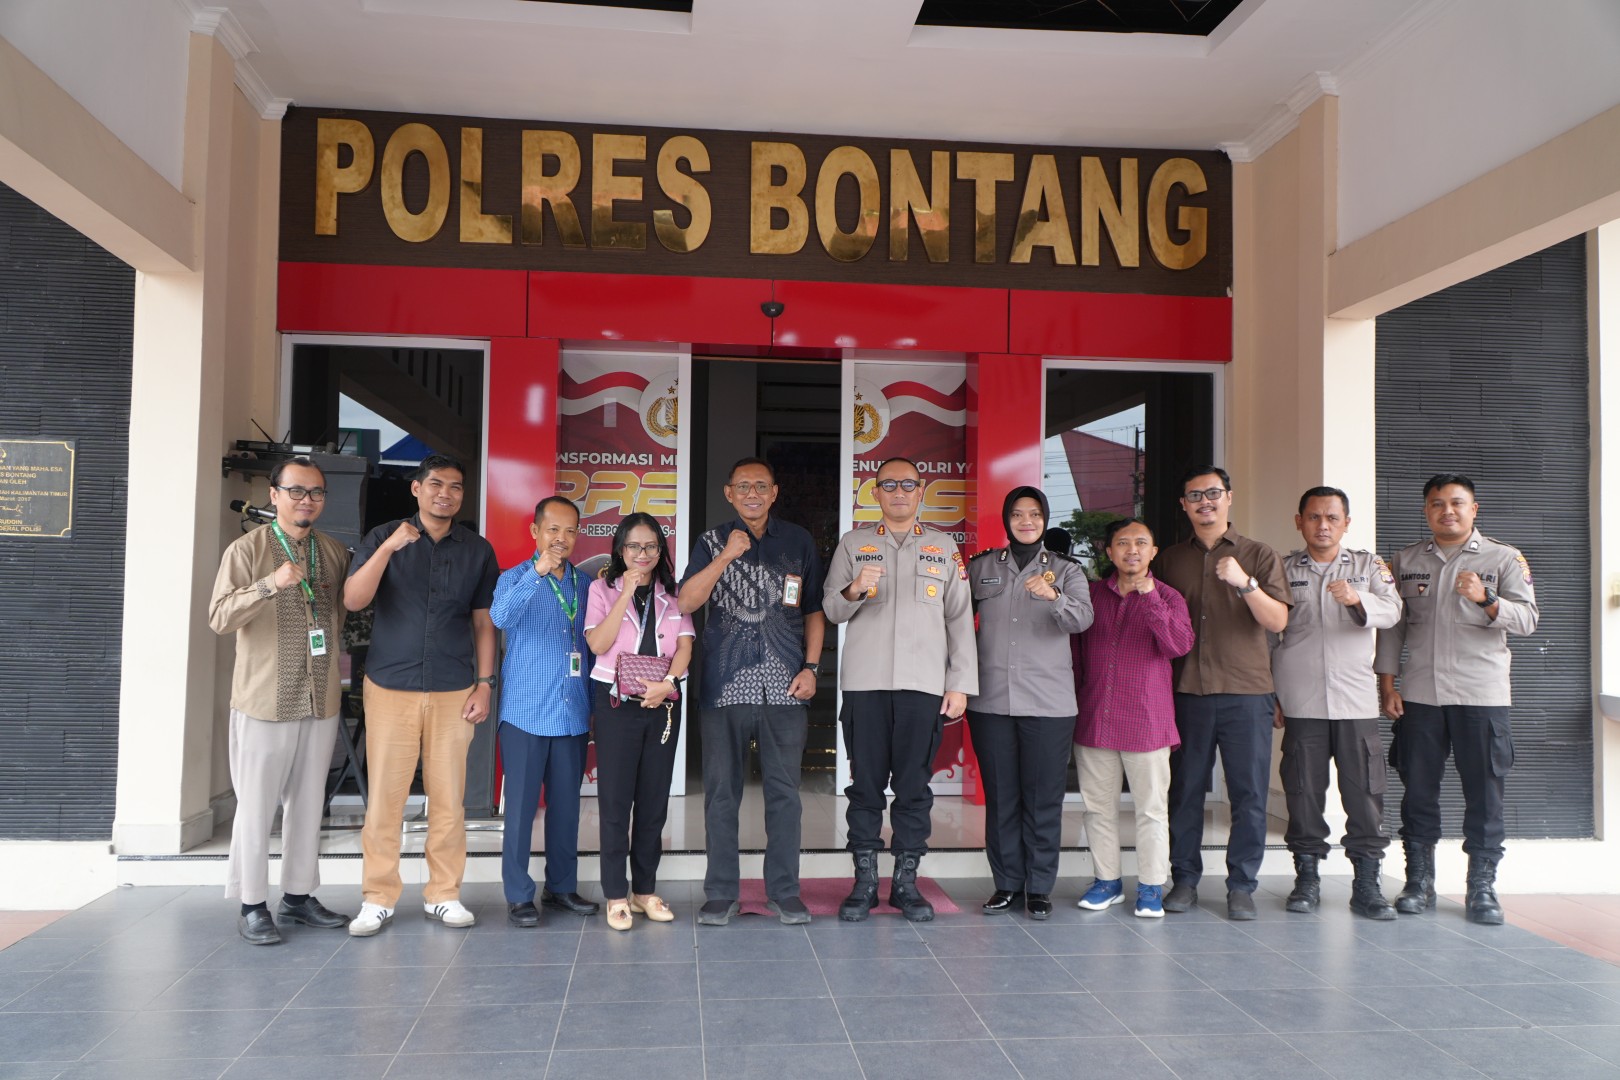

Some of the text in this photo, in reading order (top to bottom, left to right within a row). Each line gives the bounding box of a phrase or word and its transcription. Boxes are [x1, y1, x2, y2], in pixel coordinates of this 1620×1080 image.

[315, 118, 1208, 270] POLRES BONTANG
[917, 461, 952, 474] OLRI
[855, 554, 884, 562] WIDHO
[919, 555, 947, 565] POLRI
[1346, 576, 1369, 584] OLRI
[1401, 573, 1431, 581] SANTOSO
[1477, 573, 1497, 583] LRI
